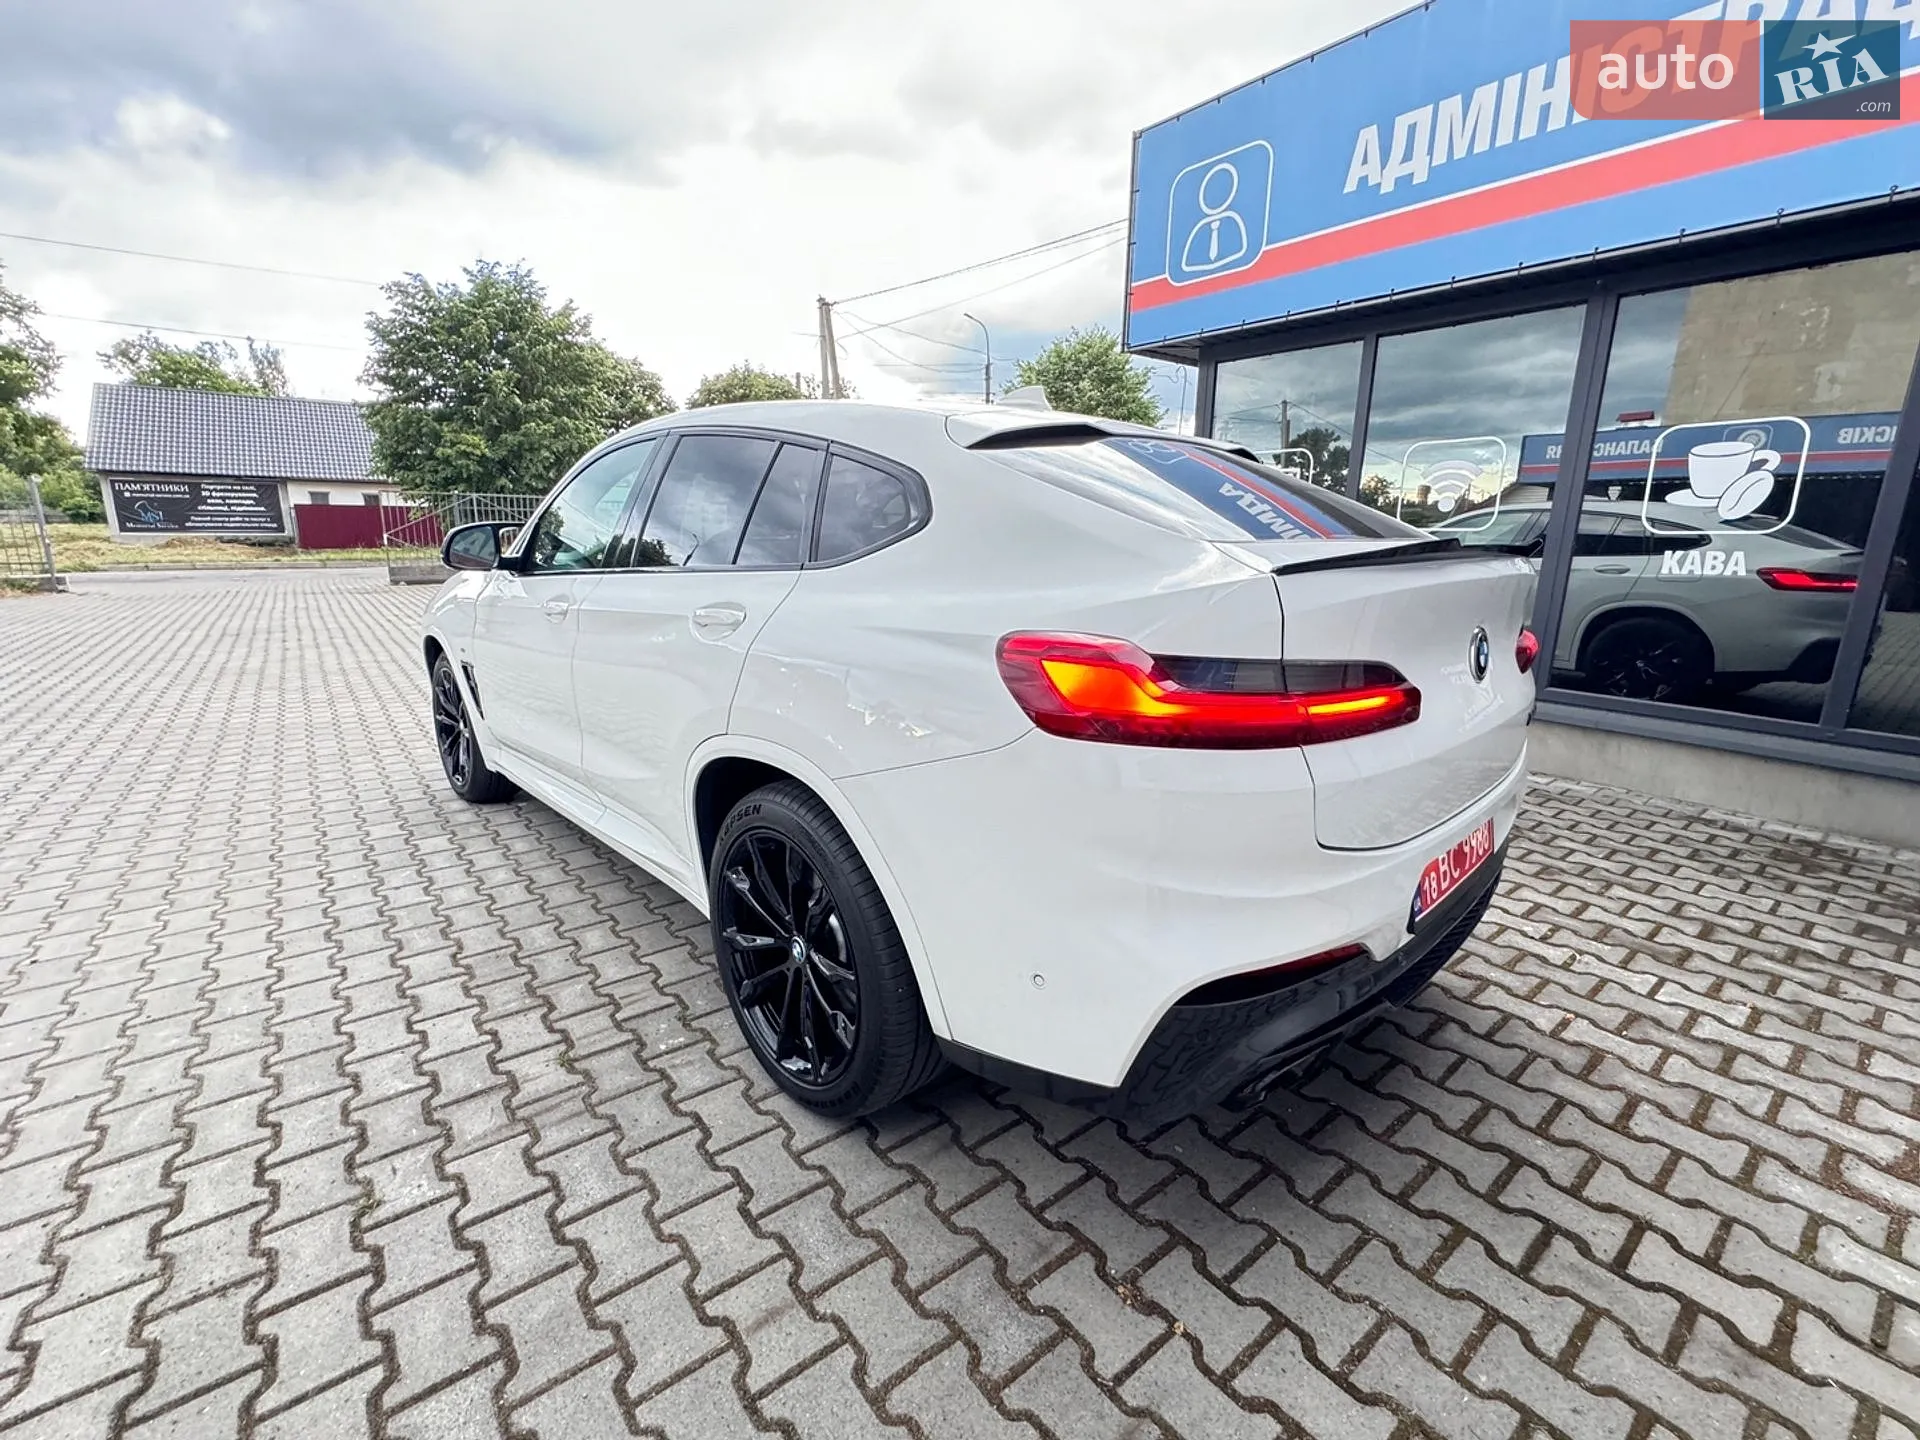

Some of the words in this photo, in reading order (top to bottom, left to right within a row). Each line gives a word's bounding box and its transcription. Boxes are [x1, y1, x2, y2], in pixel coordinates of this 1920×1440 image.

[114, 482, 190, 493] ПАМ'ЯТНИКИ
[1660, 549, 1748, 577] КАВА
[1423, 871, 1438, 905] 18
